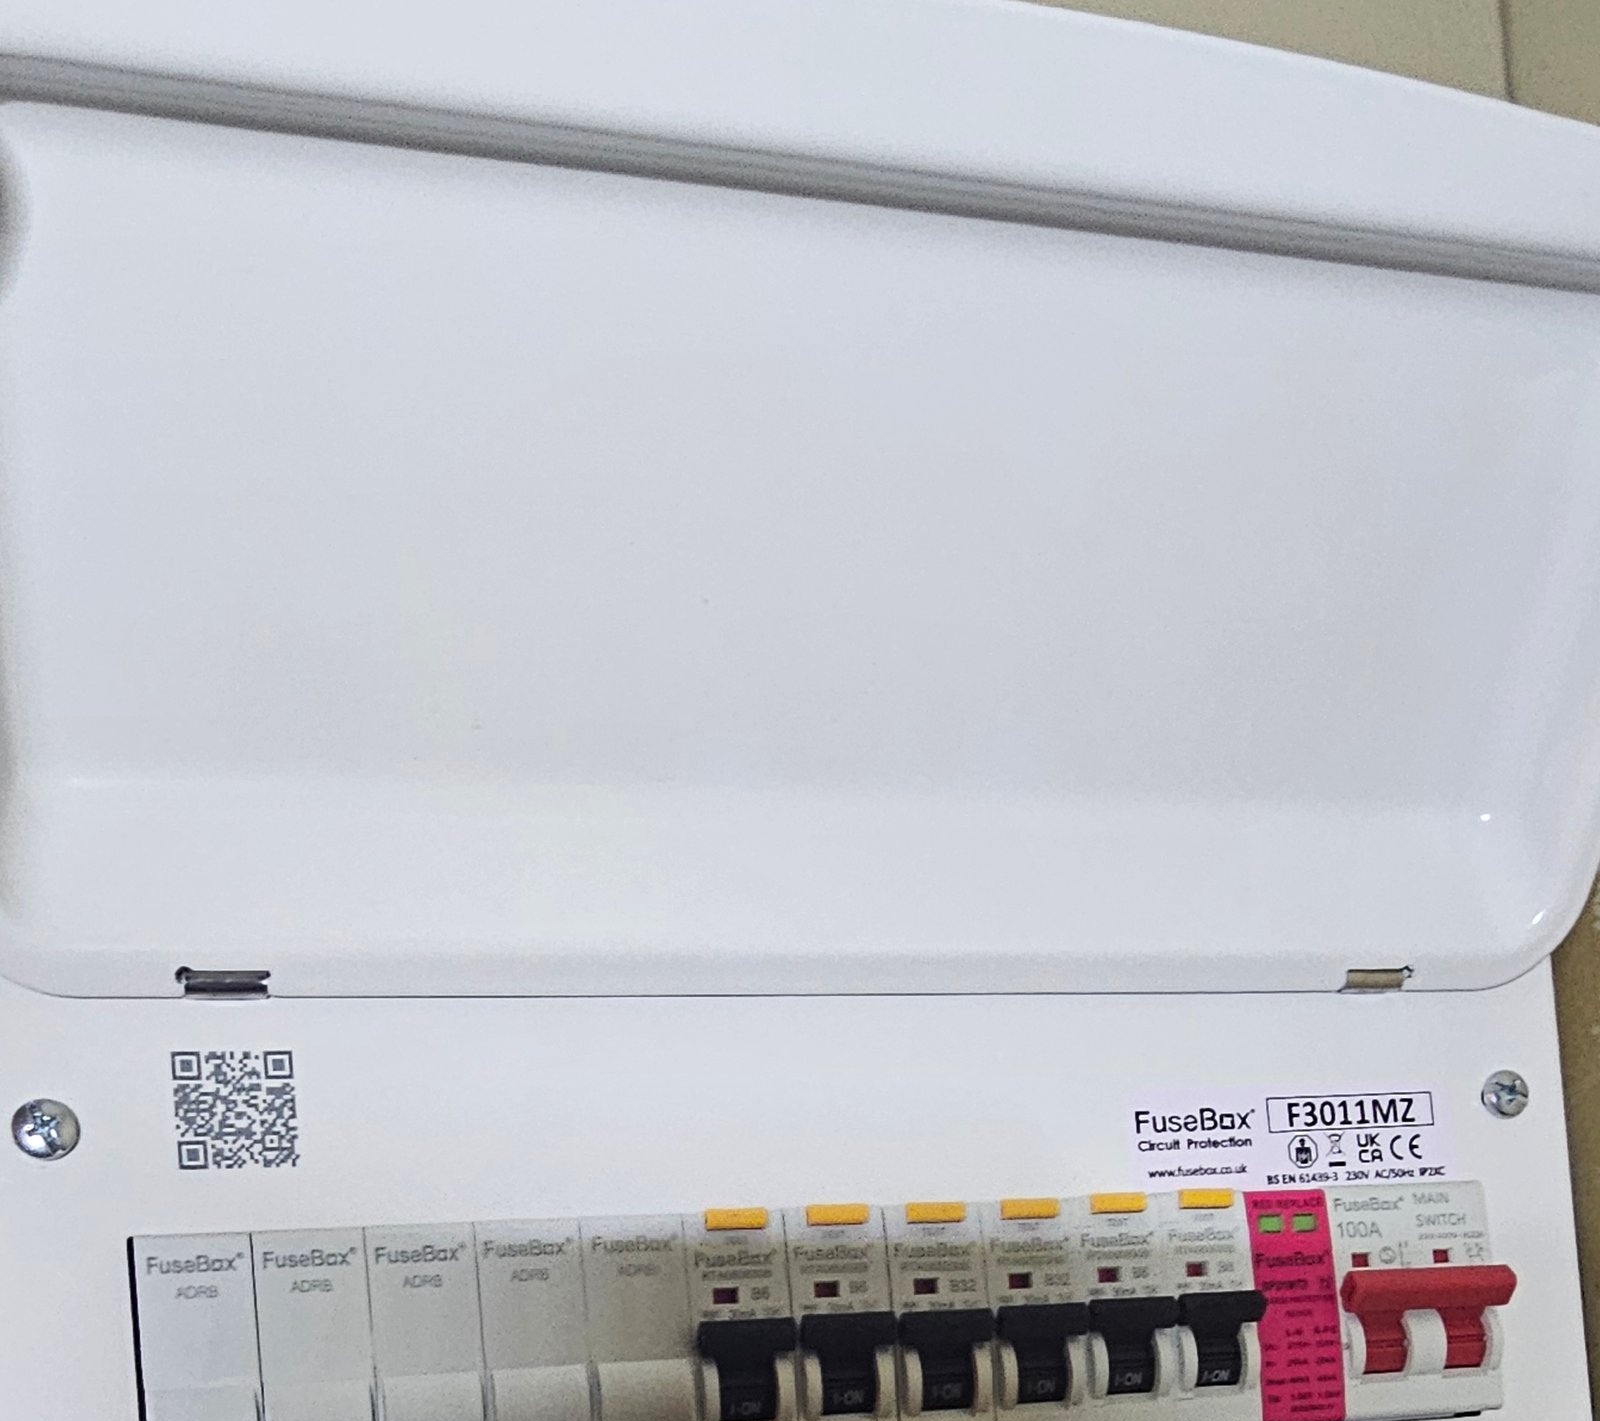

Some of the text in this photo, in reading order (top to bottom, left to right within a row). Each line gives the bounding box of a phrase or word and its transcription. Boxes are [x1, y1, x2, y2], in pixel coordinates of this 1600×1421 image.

[1287, 1098, 1416, 1127] F3011MZ
[1135, 1107, 1253, 1134] FuseBox
[1138, 1137, 1252, 1152] Circuit Protection
[1356, 1133, 1380, 1147] UK
[1148, 1164, 1247, 1178] www.fusebox.co.uk
[1267, 1175, 1279, 1184] BS
[1282, 1174, 1296, 1184] EN
[1299, 1172, 1338, 1183] 61439-3
[1345, 1170, 1369, 1180] 230V
[1375, 1169, 1414, 1179] AC/50Hz
[1411, 1191, 1449, 1205] MAIN
[1416, 1213, 1466, 1227] SWITCH
[1337, 1221, 1382, 1239] 100A
